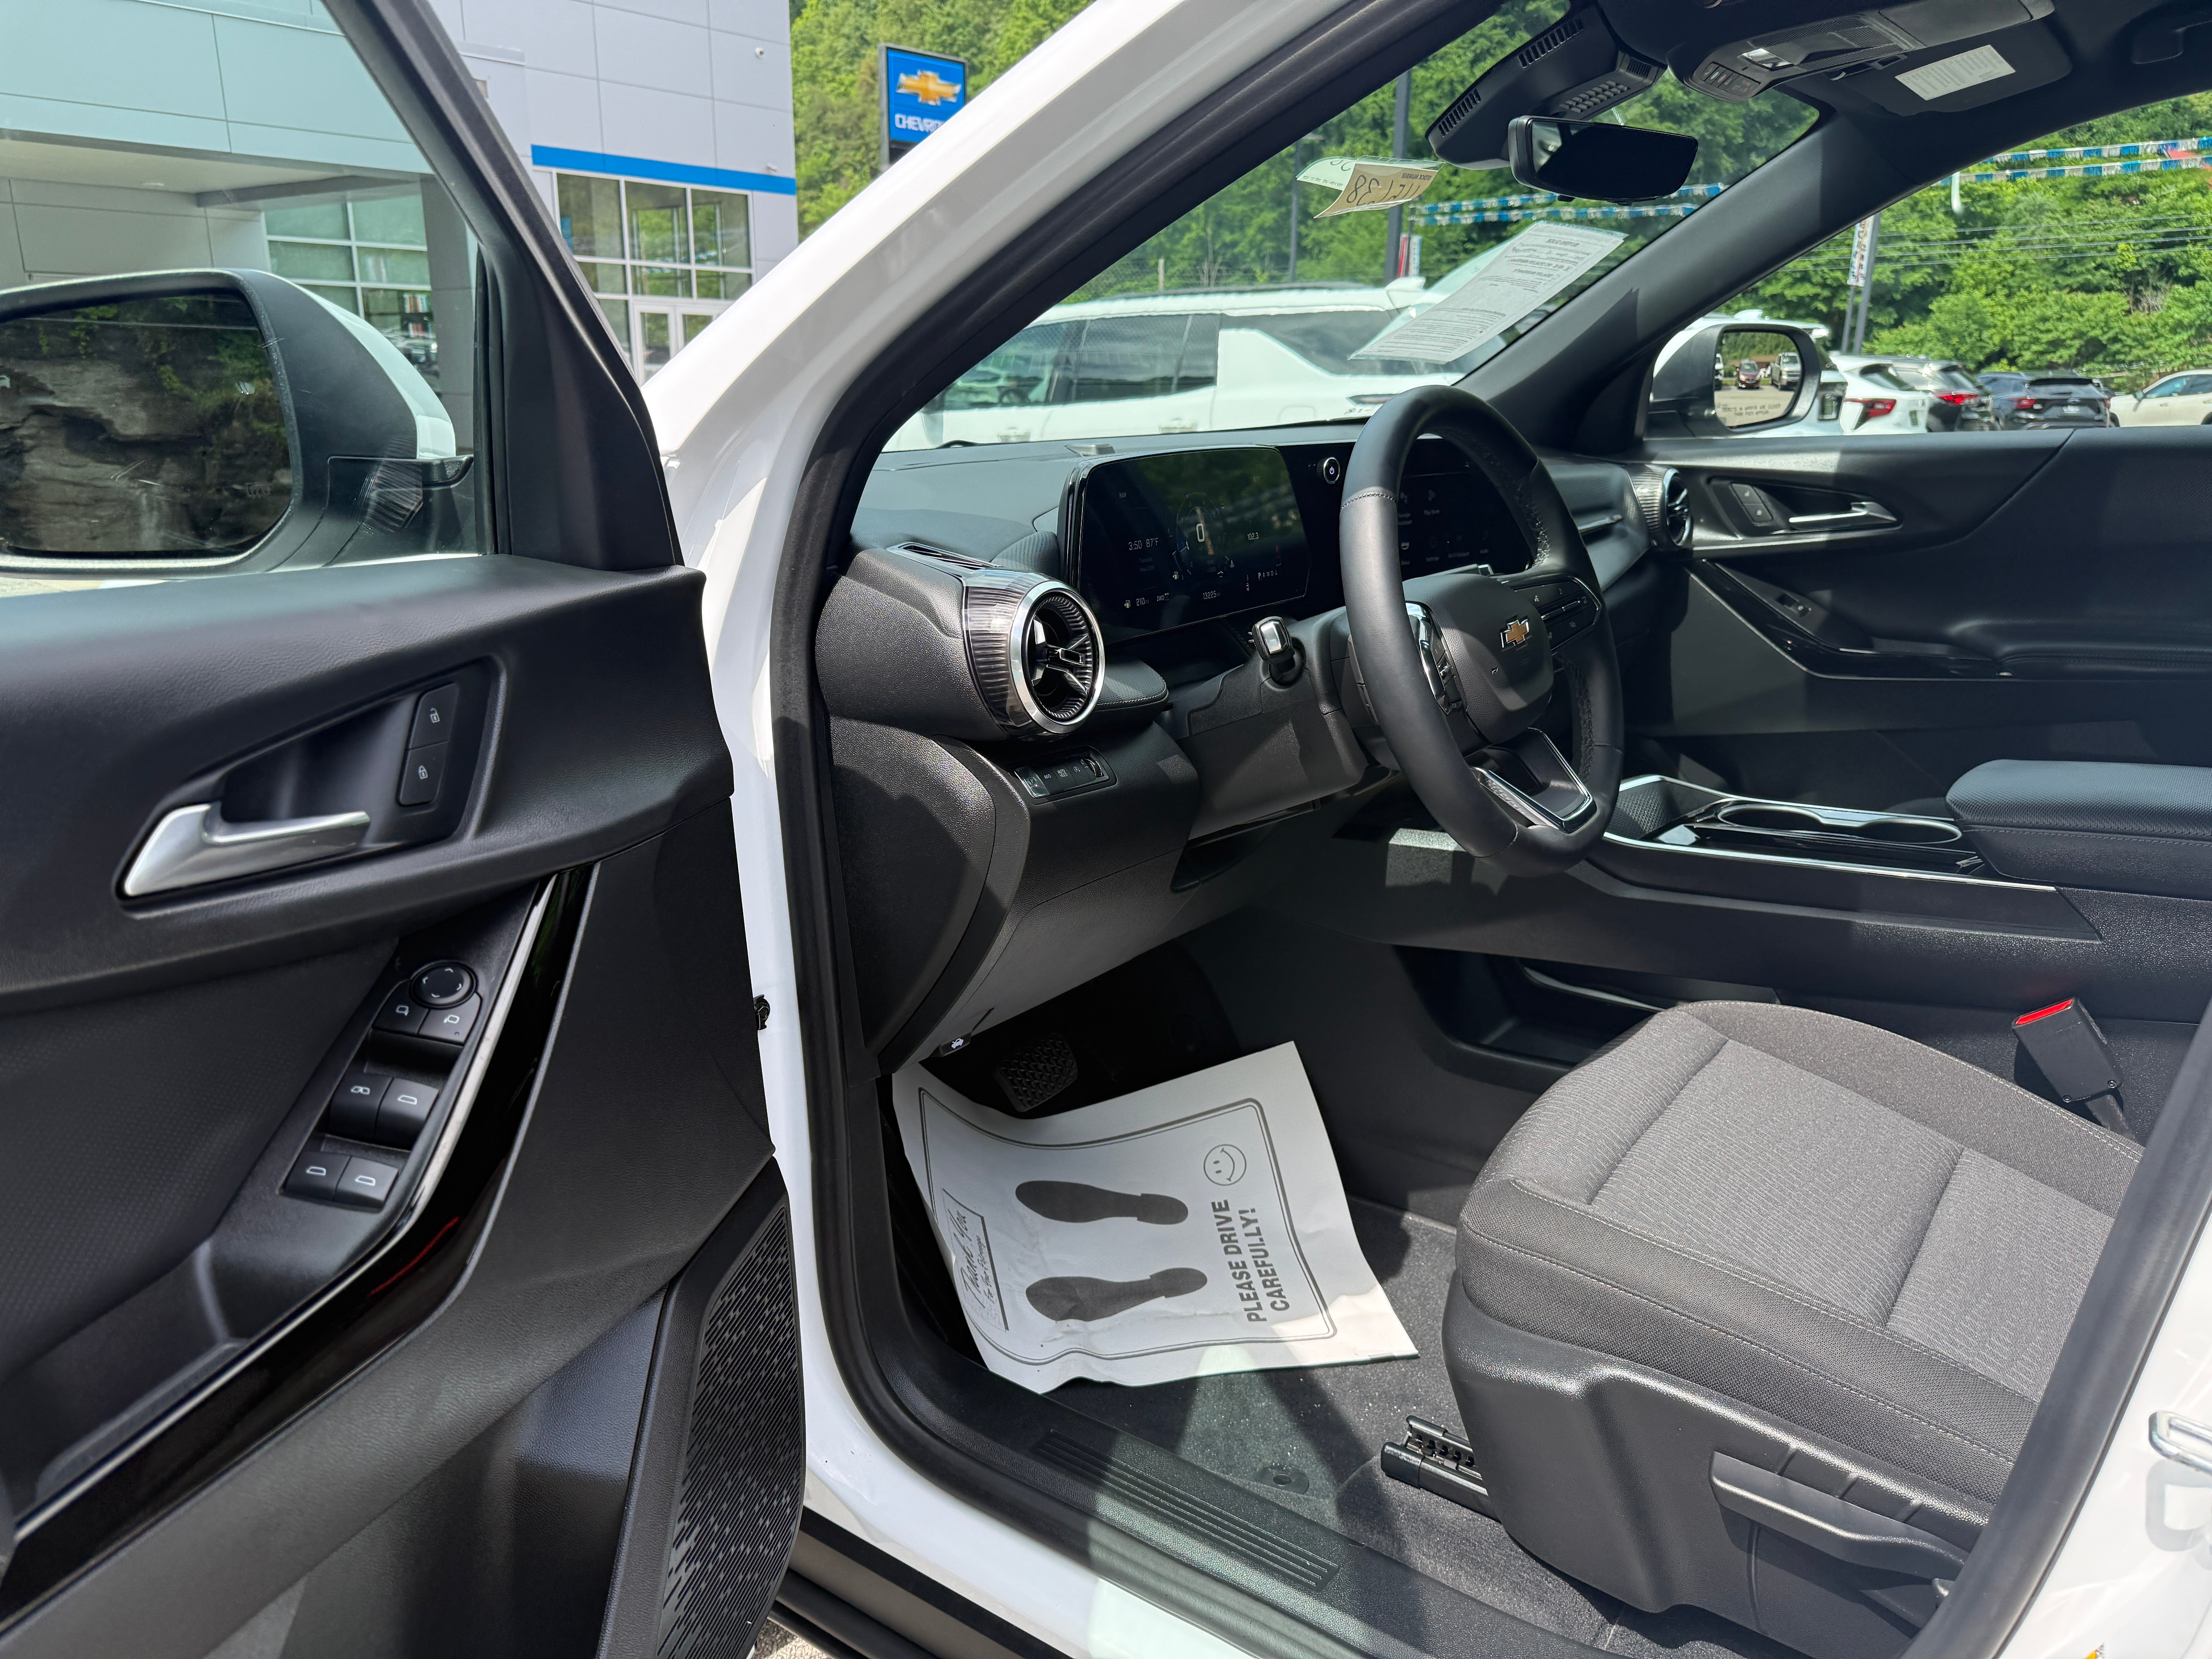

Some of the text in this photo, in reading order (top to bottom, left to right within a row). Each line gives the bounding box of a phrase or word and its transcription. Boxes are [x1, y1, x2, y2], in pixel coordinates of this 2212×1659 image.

[1128, 540, 1142, 550] 3:50
[1196, 523, 1205, 542] 0
[1203, 591, 1217, 600] 13225
[948, 1209, 986, 1309] Thank You
[1211, 1199, 1267, 1322] PLEASE DRIVE
[1238, 1208, 1290, 1311] CAREFULLY!
